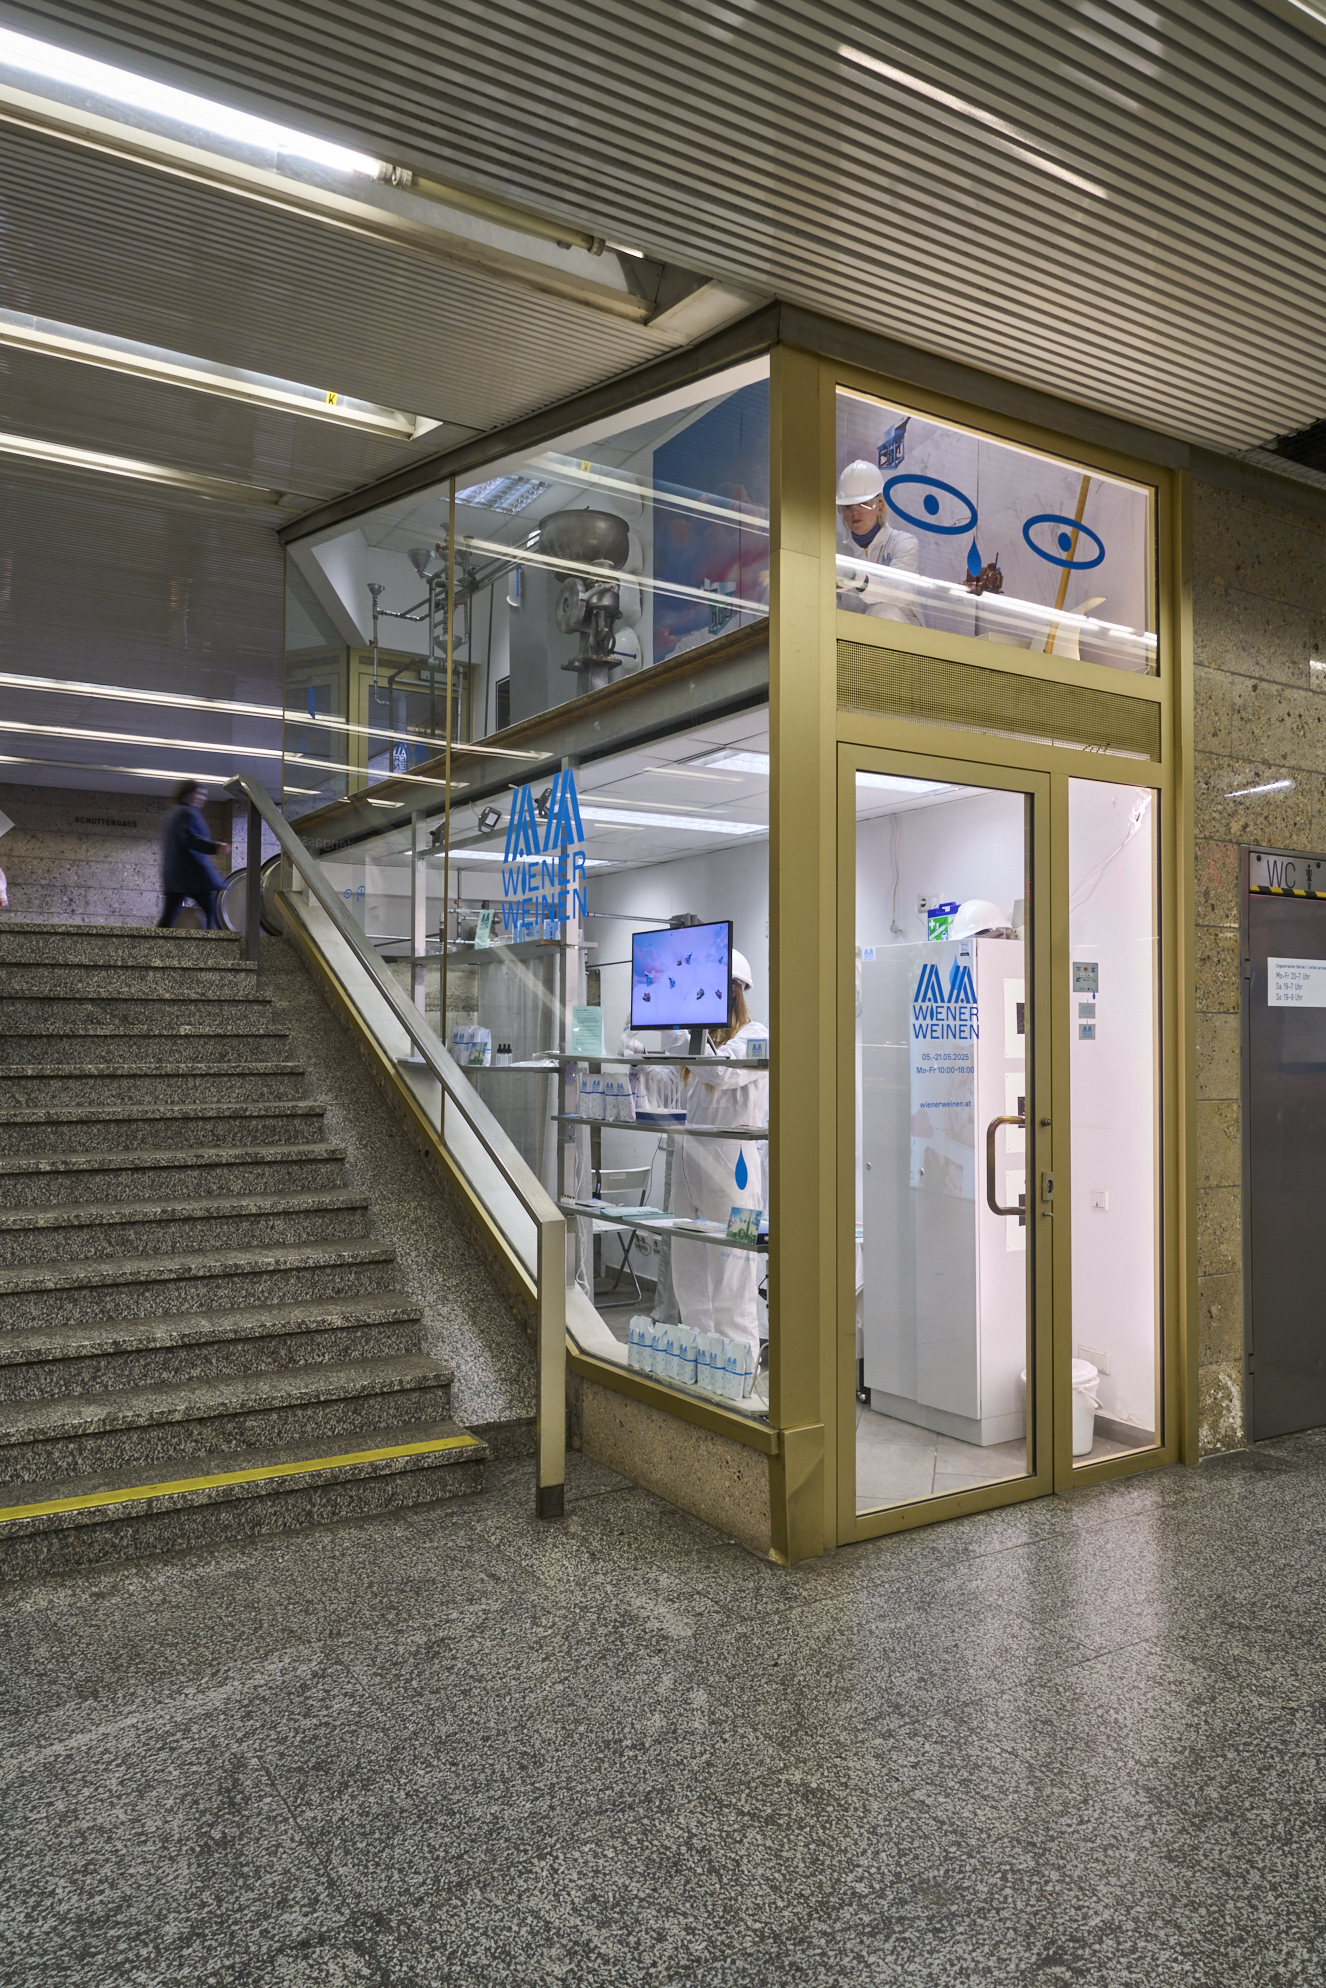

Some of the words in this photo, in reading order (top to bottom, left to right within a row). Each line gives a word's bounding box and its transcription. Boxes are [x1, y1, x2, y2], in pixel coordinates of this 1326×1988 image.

[328, 393, 336, 405] K
[502, 850, 587, 897] WIENER
[1267, 859, 1296, 889] WC
[502, 886, 587, 931] WEINEN
[1275, 982, 1282, 990] Sa
[1294, 983, 1303, 991] Uhr
[1275, 992, 1282, 1001] So
[1294, 993, 1303, 1001] Uhr
[912, 1004, 979, 1021] WIENER
[912, 1023, 980, 1040] WEINEN
[921, 1053, 970, 1061] 05.-21.05.2025
[916, 1066, 936, 1074] Mo-Fr
[937, 1066, 975, 1074] 10:00-18:00
[919, 1100, 971, 1109] wienerweinen.at
